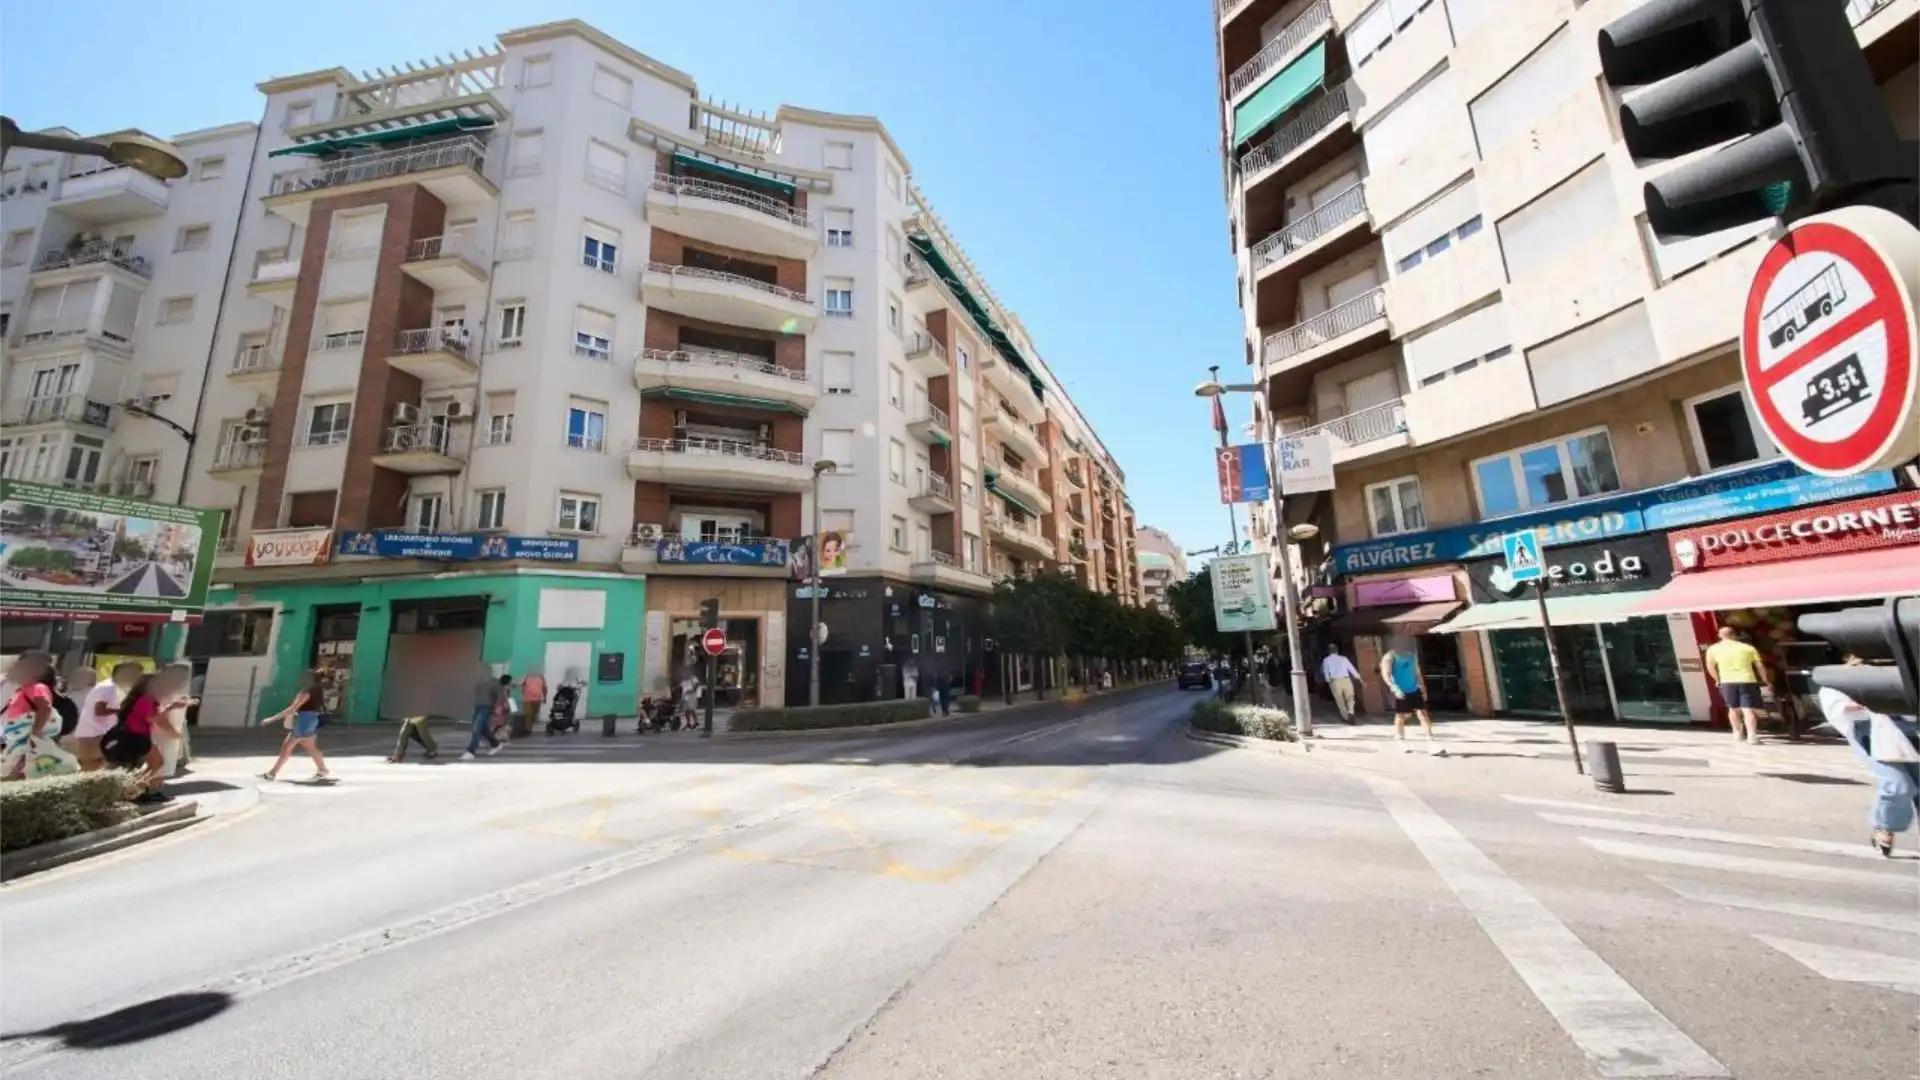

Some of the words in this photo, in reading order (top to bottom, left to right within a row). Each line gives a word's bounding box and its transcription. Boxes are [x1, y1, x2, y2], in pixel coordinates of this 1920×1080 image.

[1819, 364, 1861, 402] 3,5t
[1280, 438, 1304, 451] INS
[1282, 450, 1295, 461] PI
[1283, 458, 1311, 471] RAR
[1541, 549, 1643, 583] eoda
